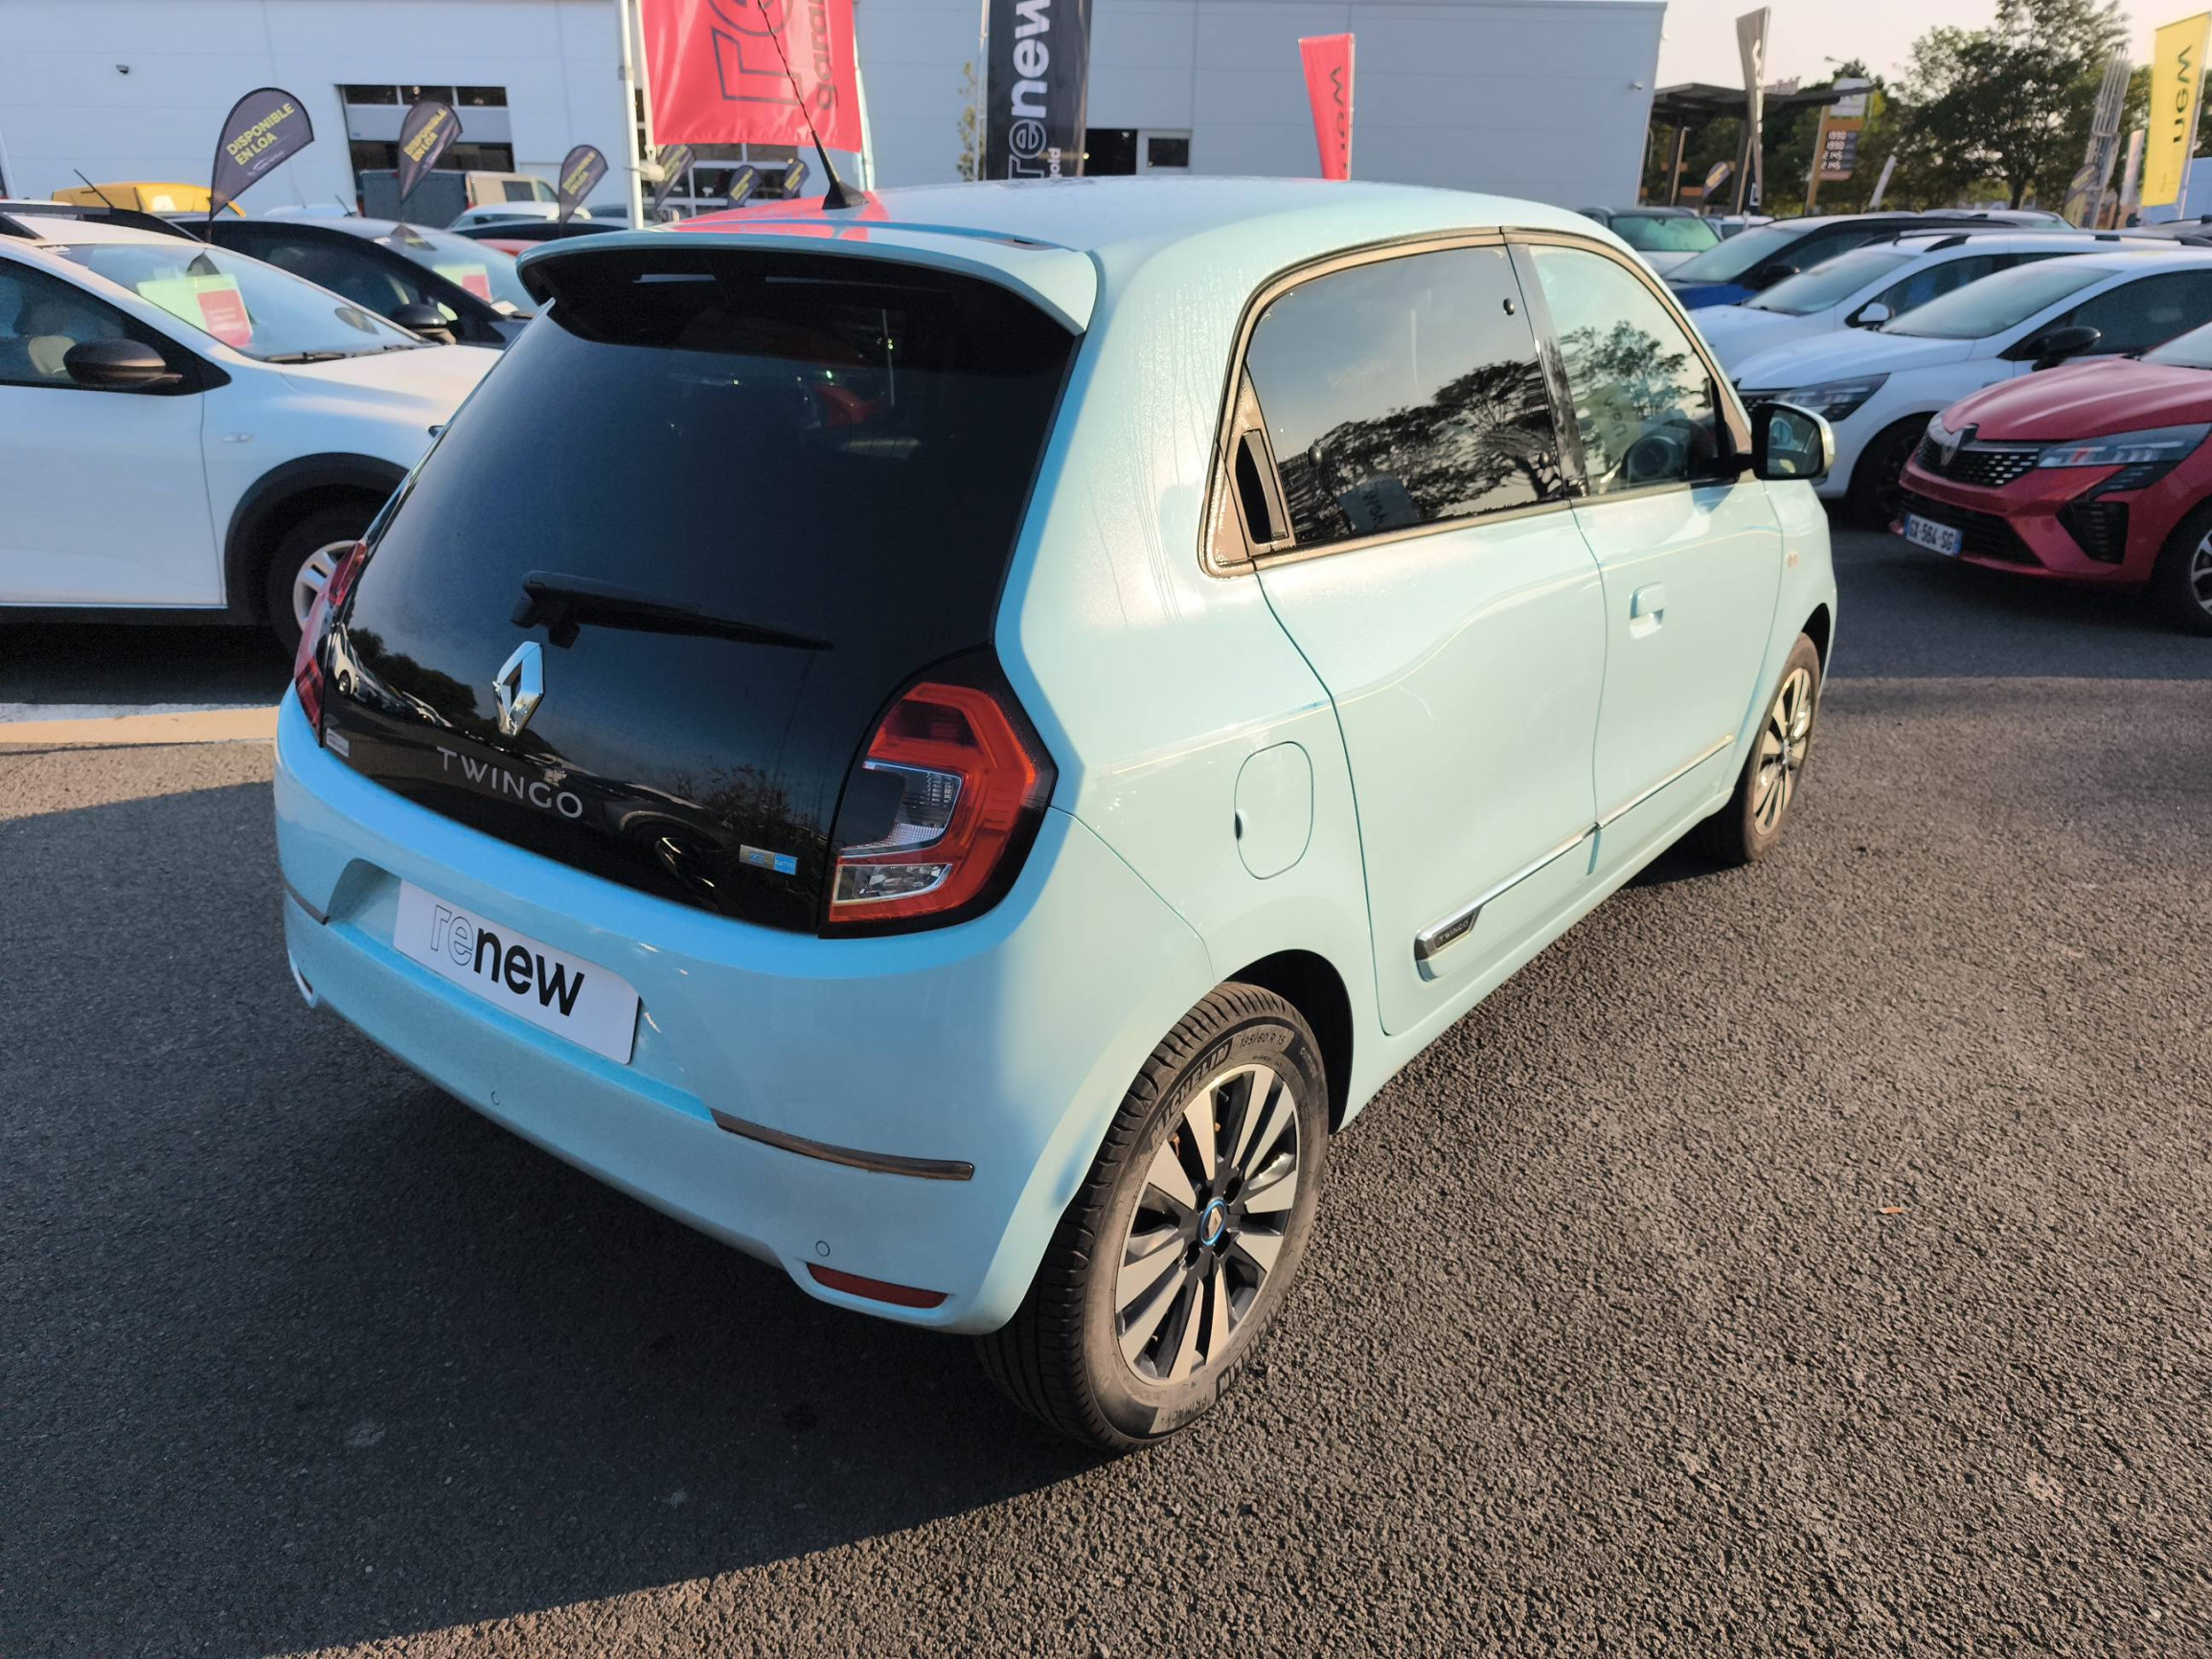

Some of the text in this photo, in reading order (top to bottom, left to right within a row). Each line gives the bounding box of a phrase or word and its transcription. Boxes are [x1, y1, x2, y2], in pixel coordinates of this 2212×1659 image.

[226, 102, 295, 155] DISPONIBLE
[235, 148, 254, 166] EN
[250, 132, 278, 153] LOA
[437, 746, 582, 818] TWINGO
[430, 904, 585, 1017] renew
[1439, 920, 1470, 943] TWINGO
[1150, 1042, 1230, 1148] MICHELIN
